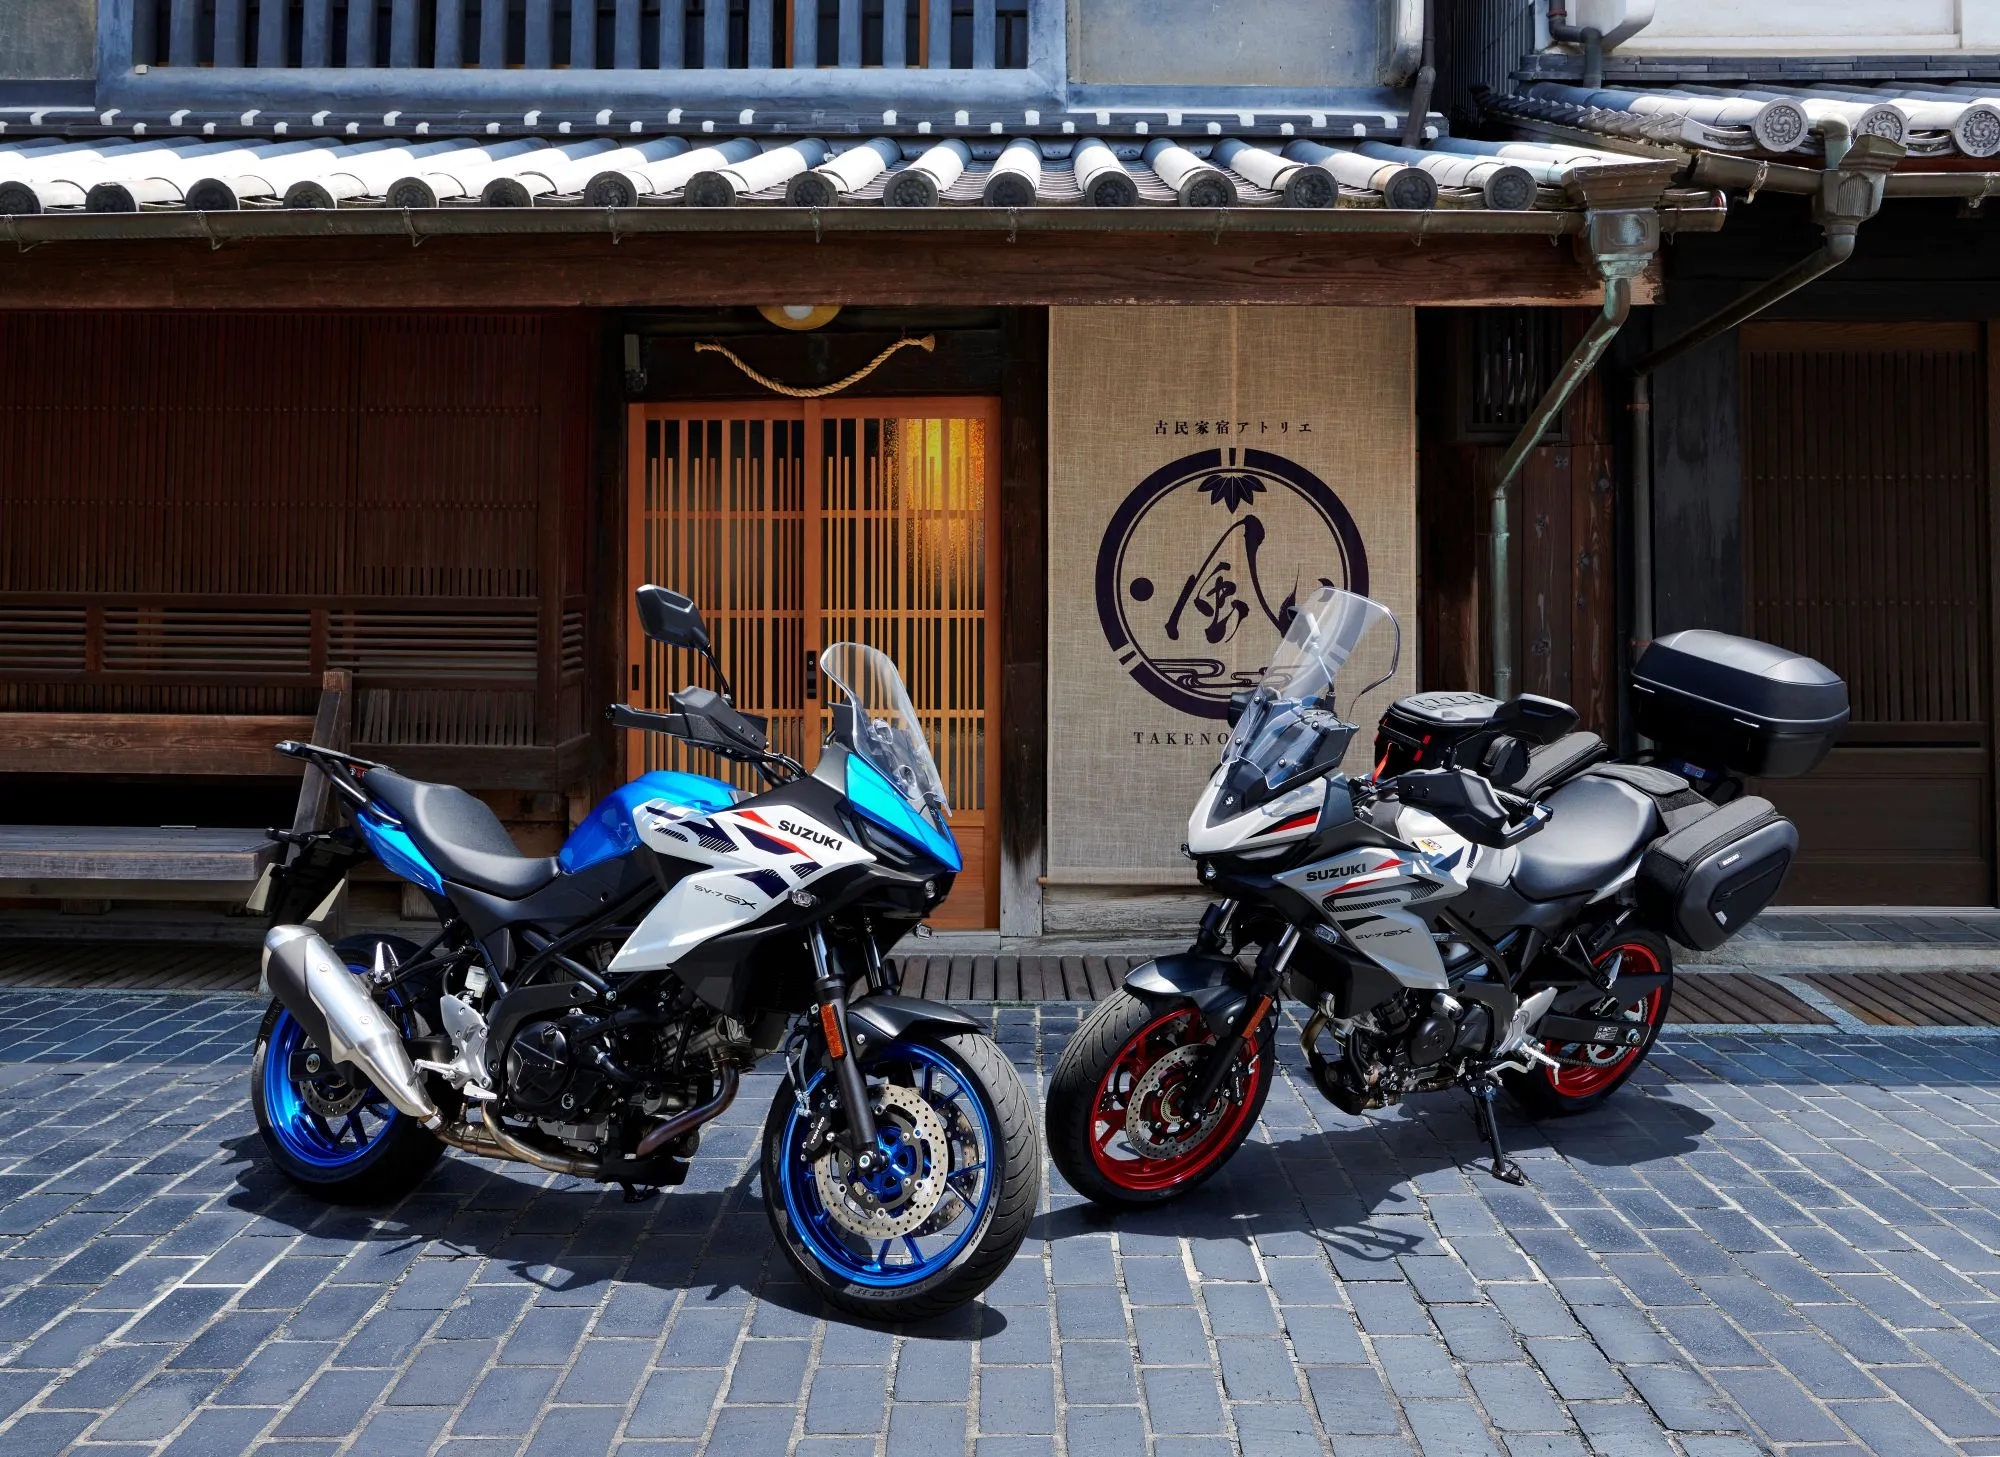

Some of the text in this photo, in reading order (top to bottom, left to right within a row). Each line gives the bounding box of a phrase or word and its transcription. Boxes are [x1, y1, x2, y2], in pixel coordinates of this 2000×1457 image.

[1154, 420, 1312, 435] 古民家宿アトリエ
[778, 820, 843, 851] SUZUKI
[1306, 863, 1366, 881] SUZUKI
